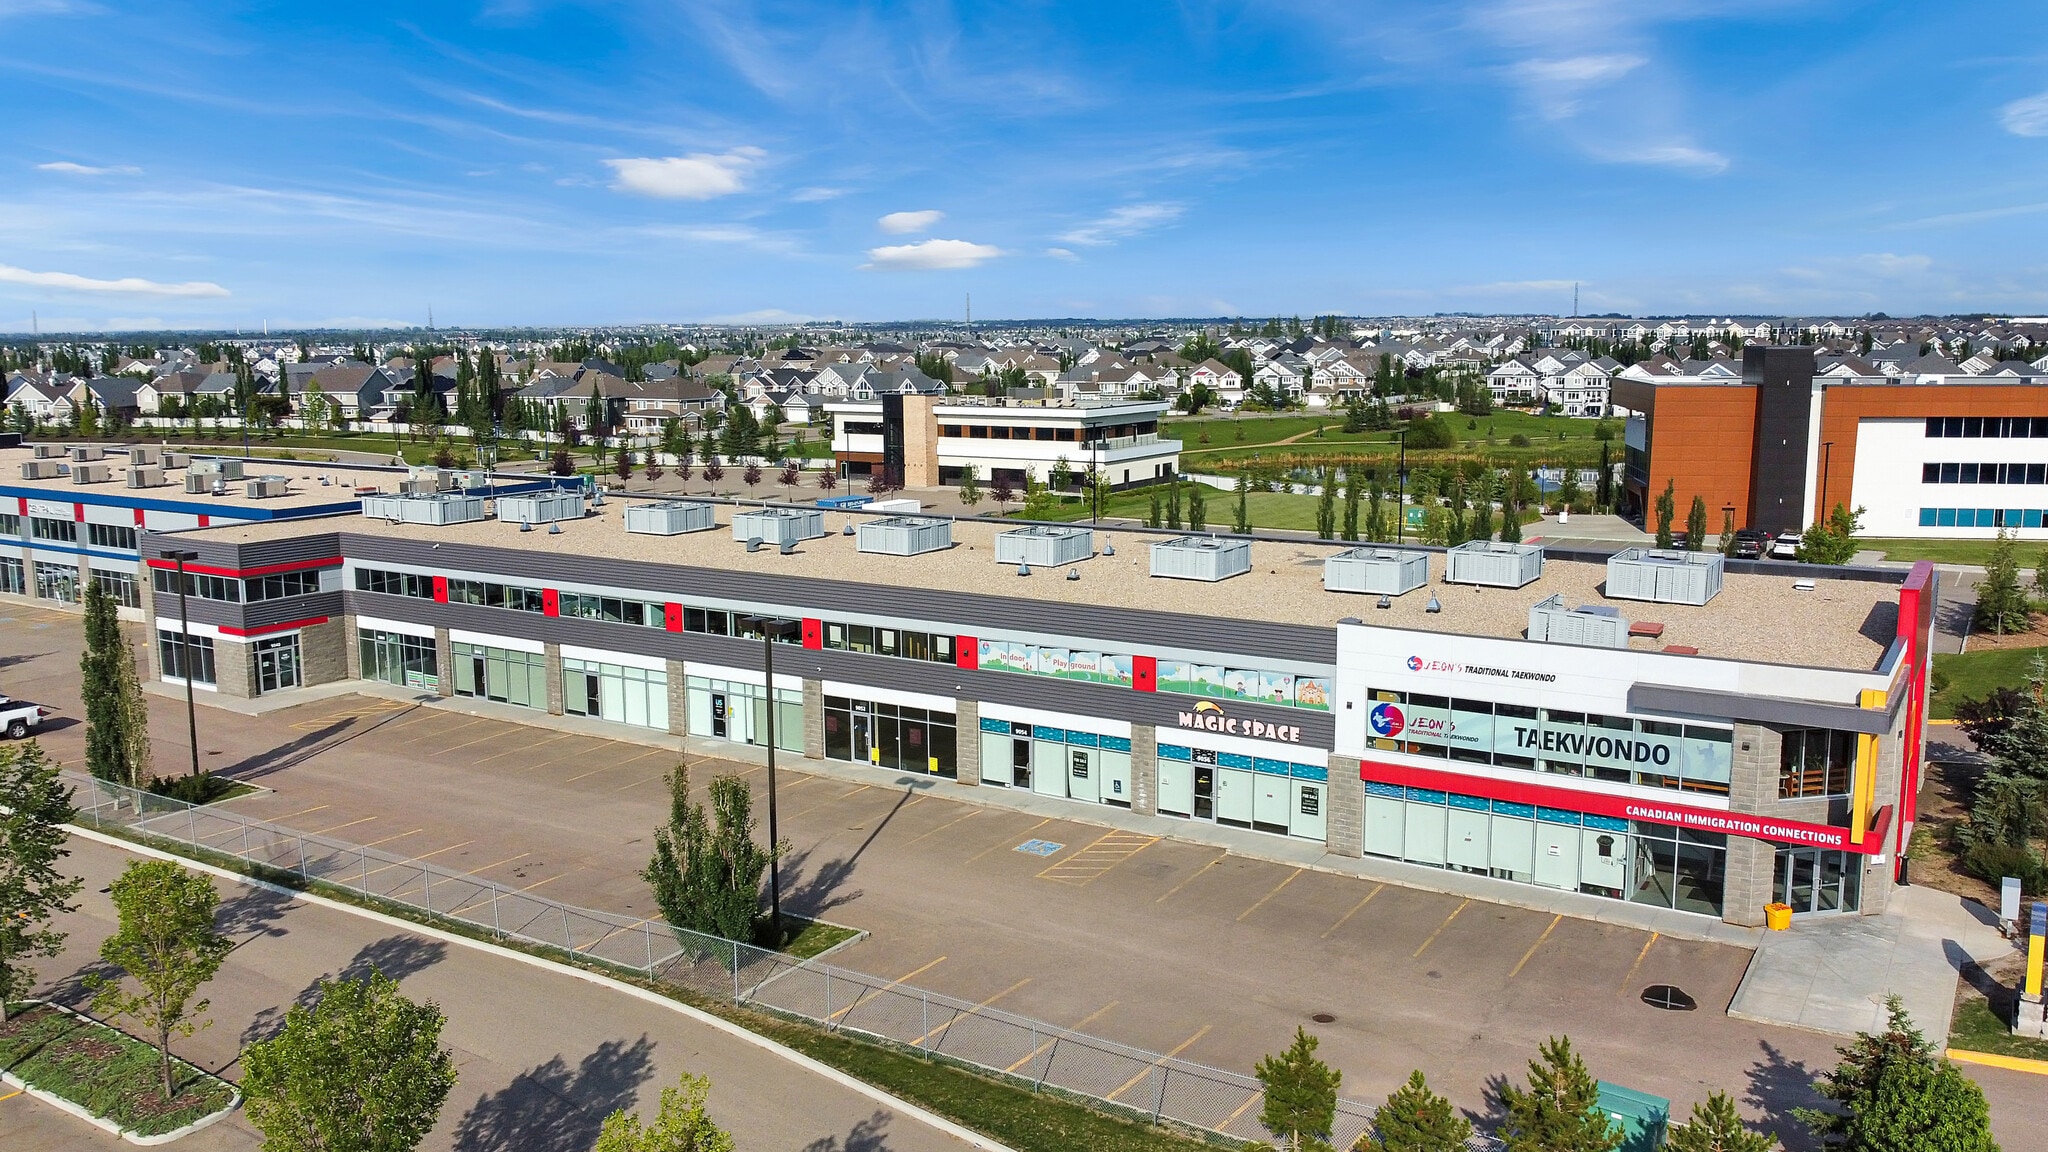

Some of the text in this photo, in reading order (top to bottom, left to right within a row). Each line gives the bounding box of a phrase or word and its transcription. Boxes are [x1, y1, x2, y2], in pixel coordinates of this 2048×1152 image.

[1423, 660, 1556, 683] JEON'S TRADITIONAL TAEKWONDO
[1178, 711, 1300, 742] MAGIC SPACE
[1408, 728, 1442, 738] TRADITIONAL
[1409, 717, 1456, 732] JEON'S
[1514, 726, 1670, 766] TAEKWONDO
[1626, 805, 1842, 845] CANADIAN IMMIGRATION CONNECTIONS
